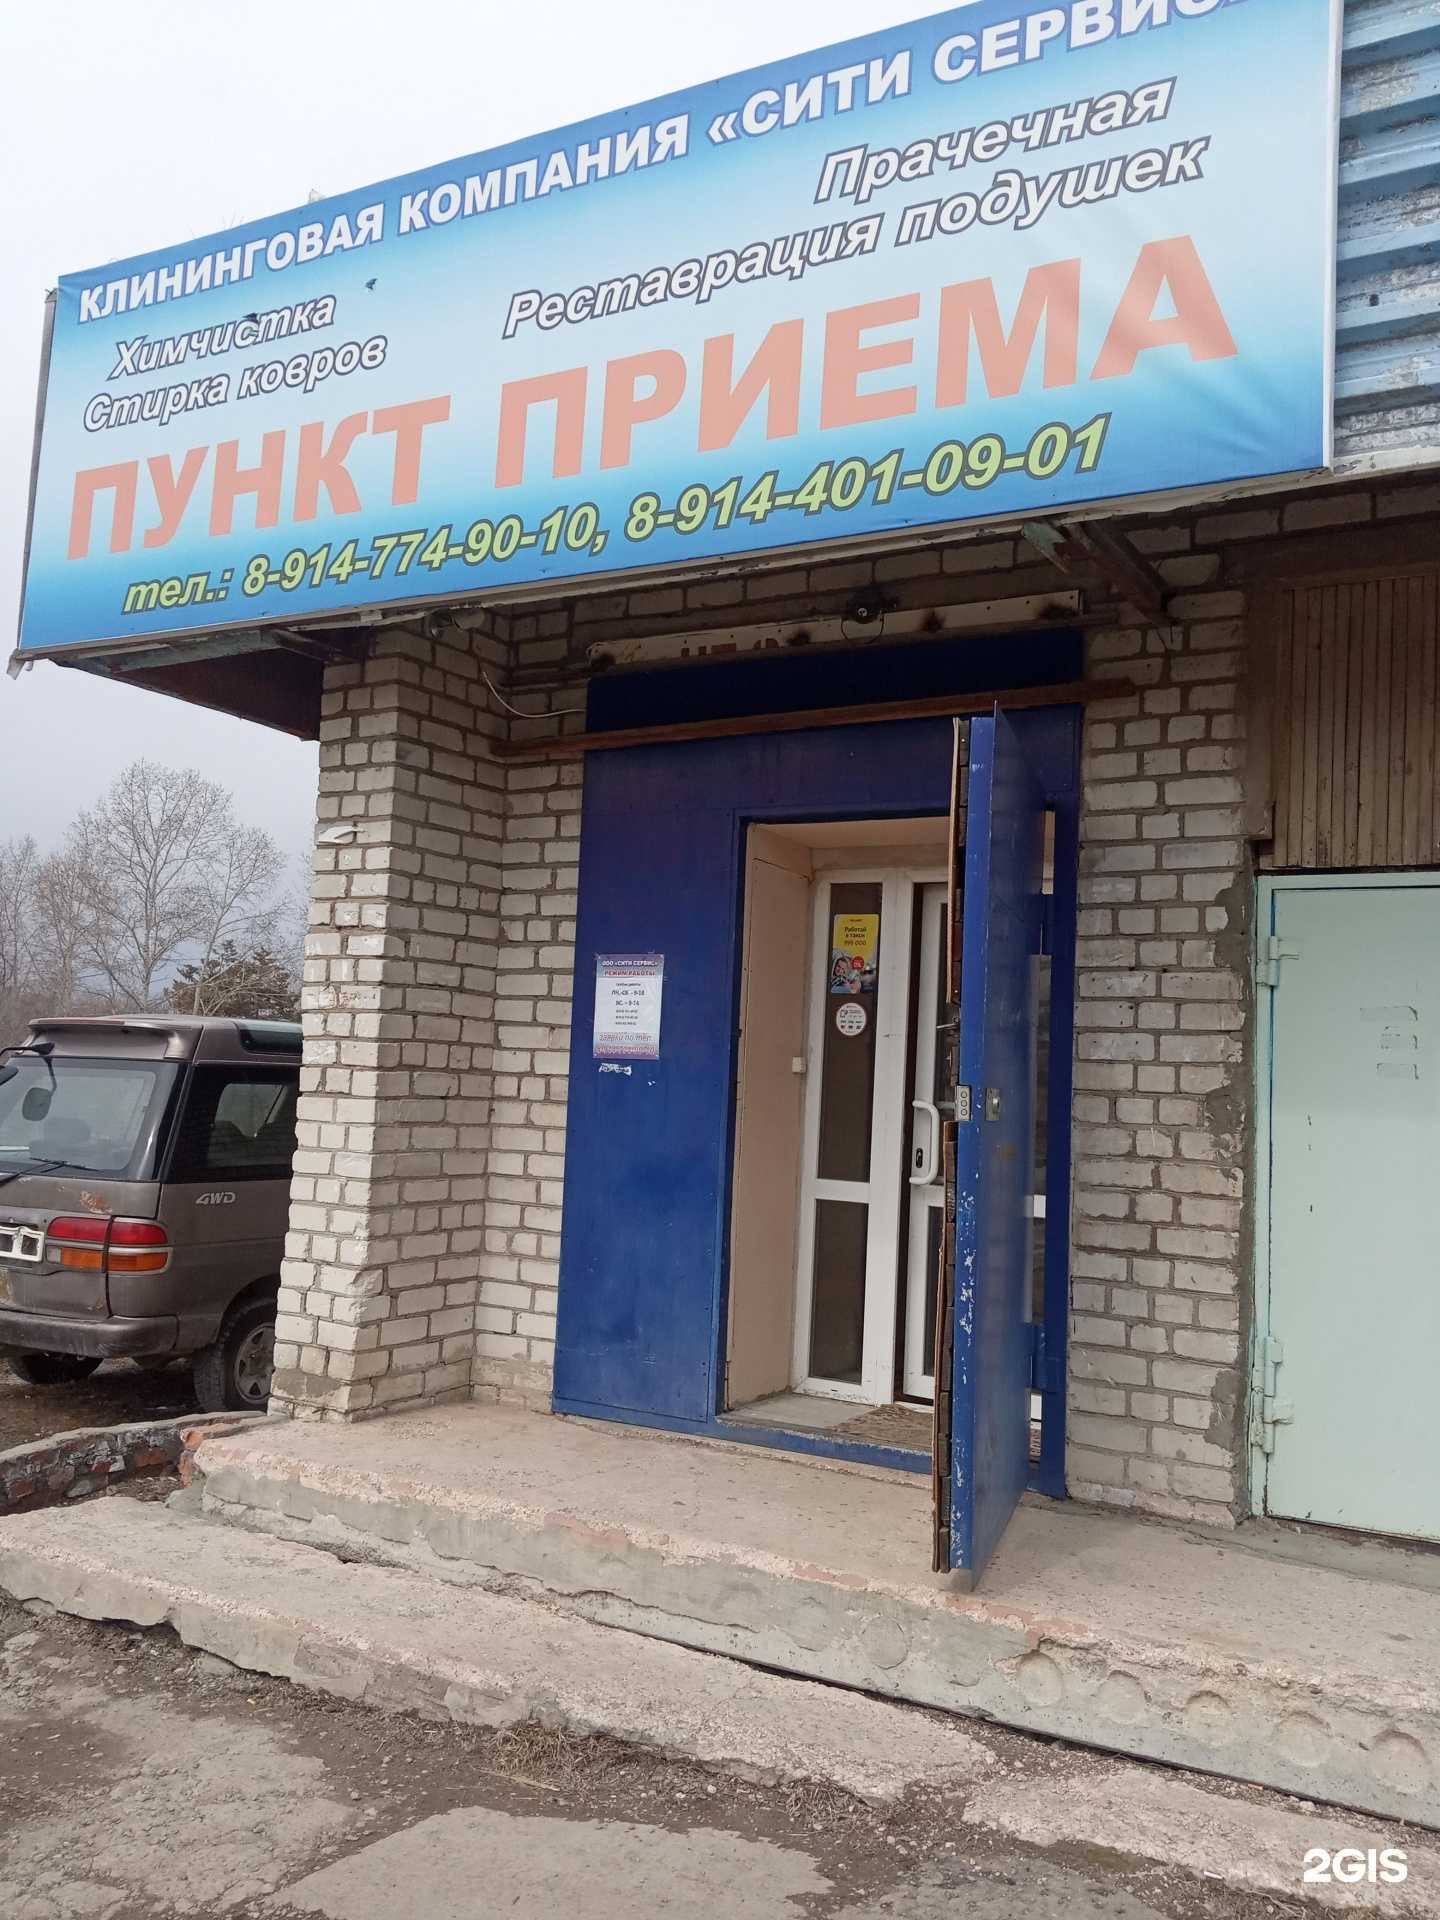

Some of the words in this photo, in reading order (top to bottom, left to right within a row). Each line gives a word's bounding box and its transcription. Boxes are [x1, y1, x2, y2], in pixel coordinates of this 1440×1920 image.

[77, 204, 387, 323] КЛИНИНГОВАЯ
[397, 112, 691, 236] КОМПАНИЯ
[705, 50, 913, 147] «СИТИ
[932, 0, 1250, 84] СЕРВИ
[814, 76, 1178, 204] Прачечная
[502, 212, 885, 340] Реставрация
[894, 136, 1211, 248] подушек
[67, 395, 451, 560] ПУНКТ
[495, 235, 1238, 488] ПРИЕМА
[83, 370, 230, 432] Стирка
[236, 335, 389, 400] ковров
[107, 294, 337, 381] Химчистка
[121, 564, 232, 615] тел.:
[241, 501, 609, 597] 8-914-774-90-10,
[624, 412, 1112, 542] 8-914-401-09-01
[195, 1191, 236, 1206] 4WD
